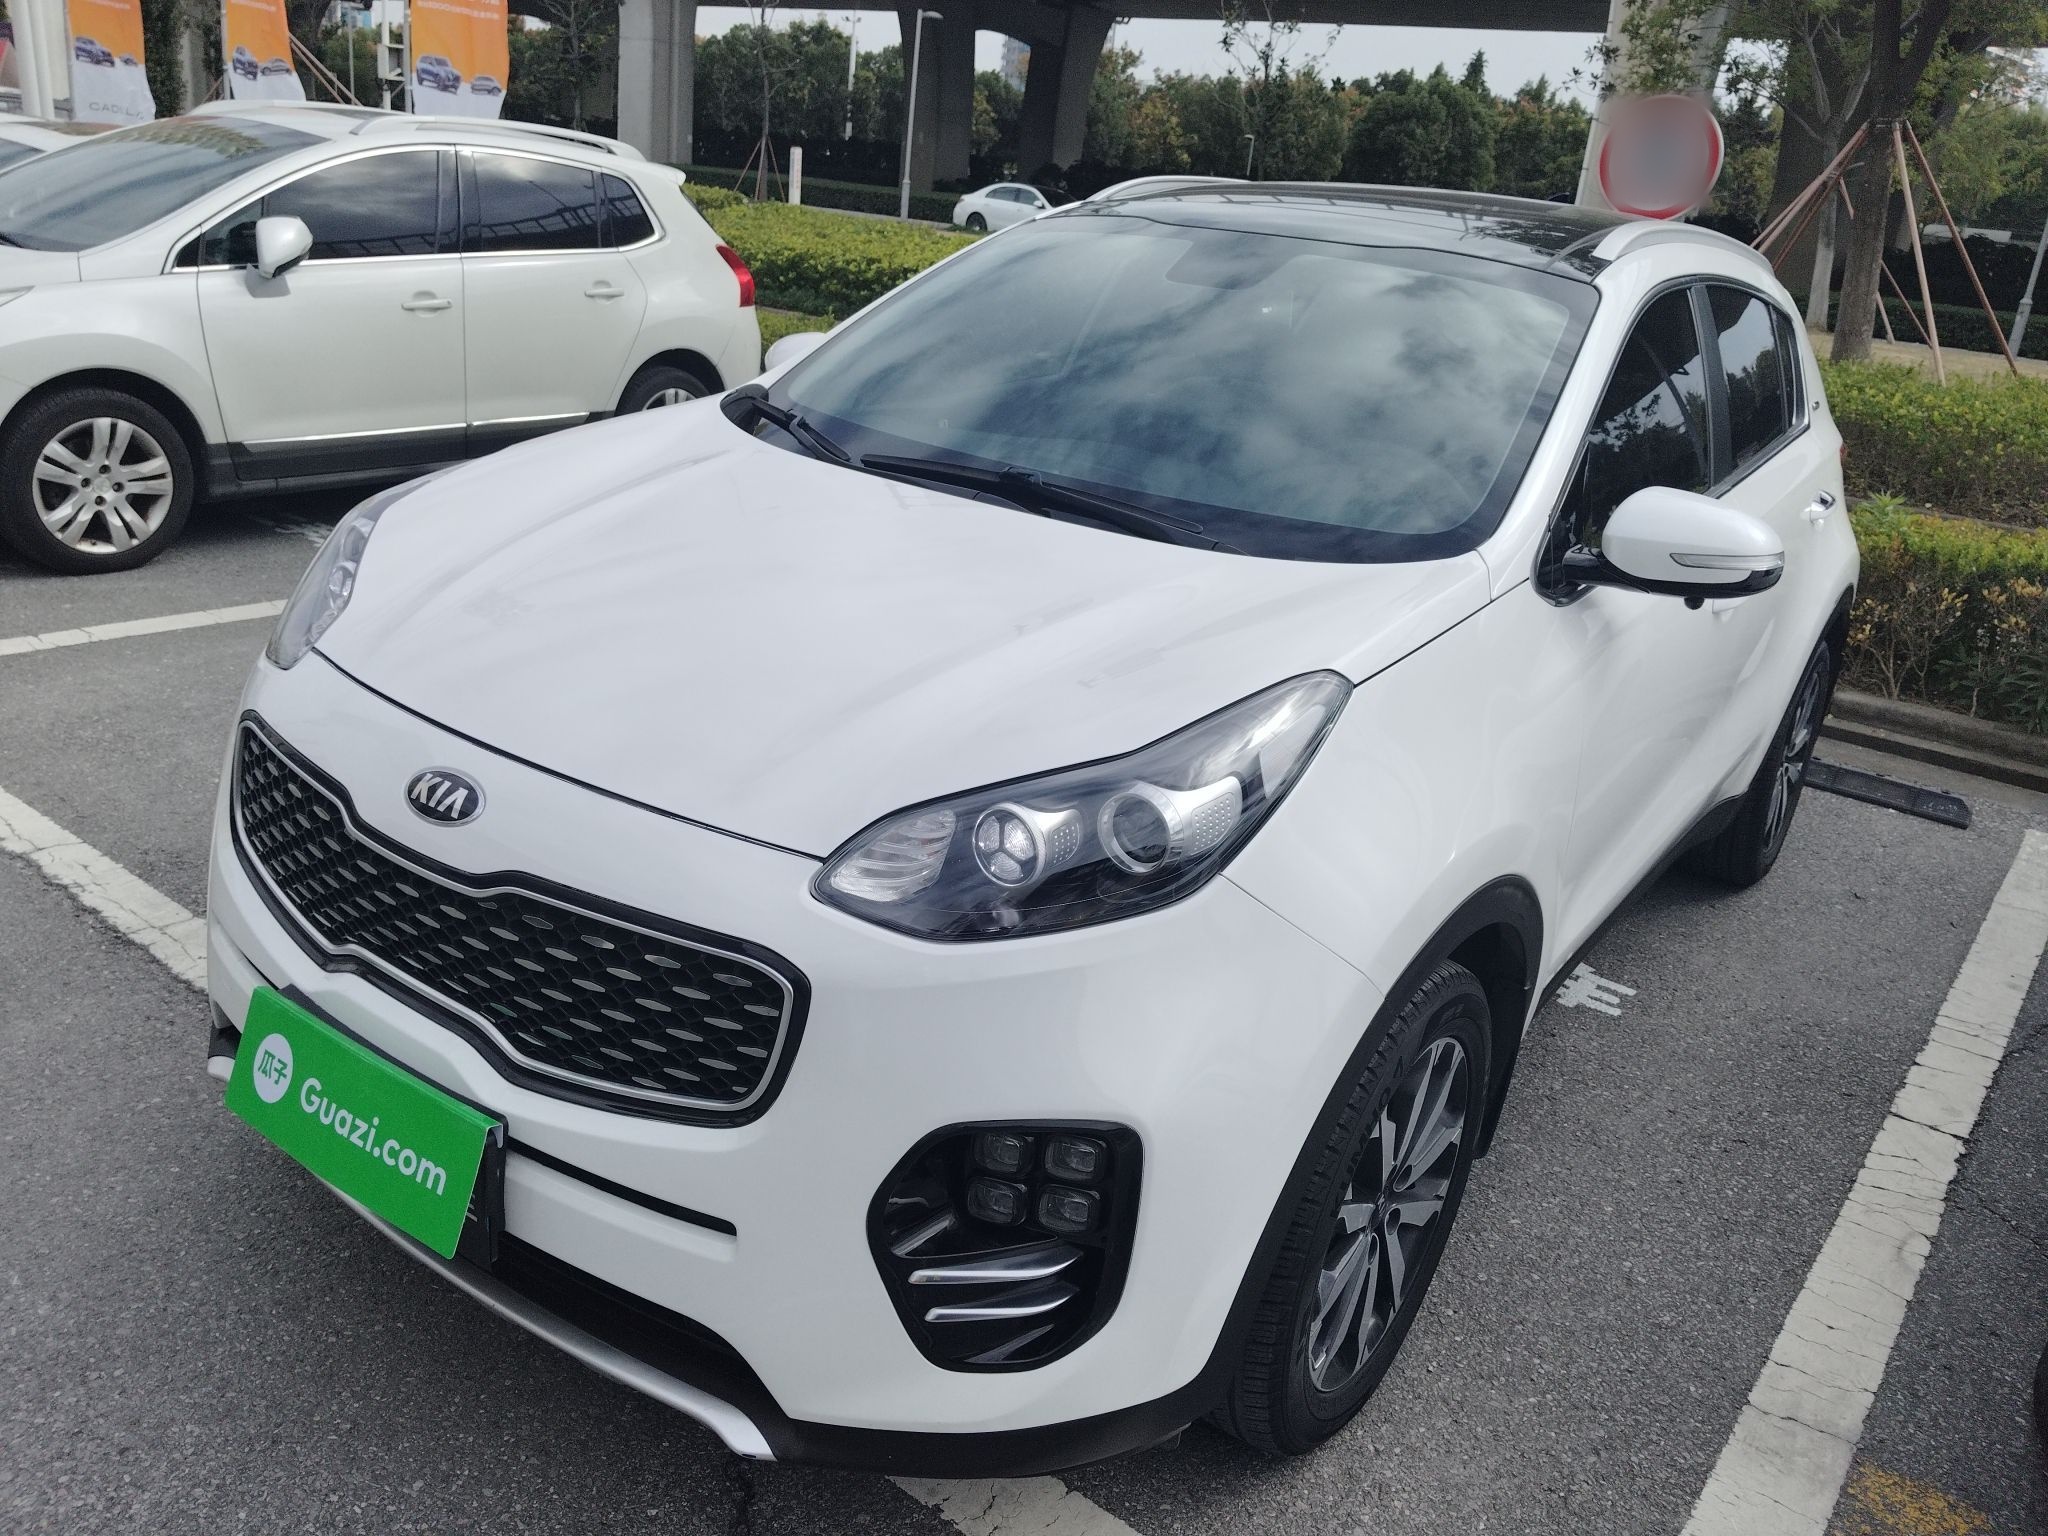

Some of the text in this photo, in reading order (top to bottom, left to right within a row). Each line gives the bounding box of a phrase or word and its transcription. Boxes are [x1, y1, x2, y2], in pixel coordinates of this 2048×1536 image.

[410, 772, 469, 820] KIA
[257, 1049, 288, 1085] 瓜子
[300, 1077, 448, 1196] Guazi.com
